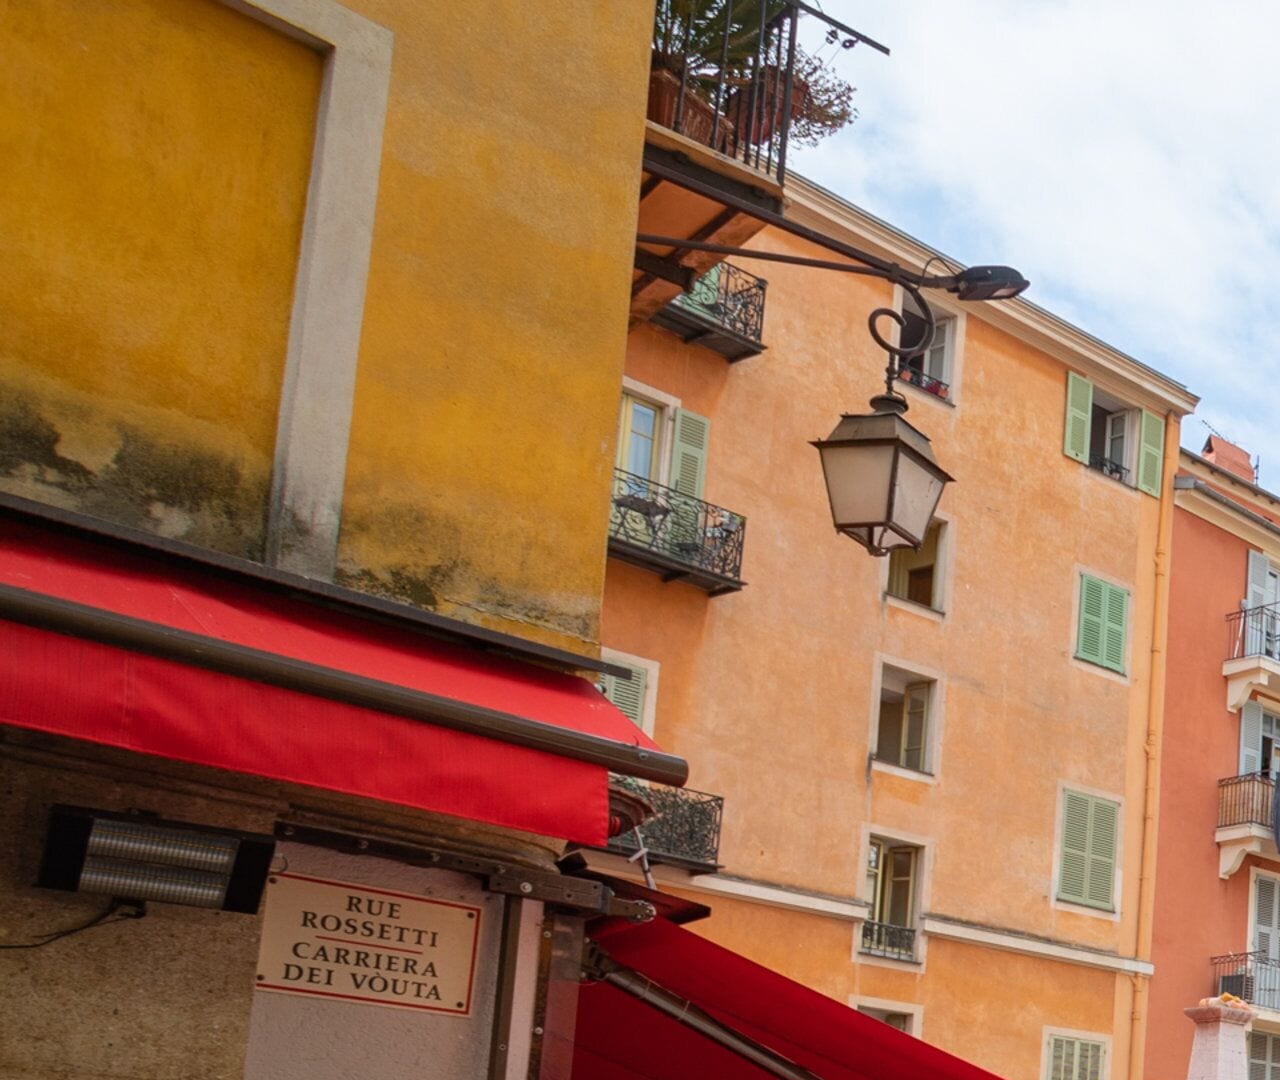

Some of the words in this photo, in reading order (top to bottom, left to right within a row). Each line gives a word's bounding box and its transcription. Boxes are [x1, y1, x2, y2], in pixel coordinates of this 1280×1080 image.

[345, 895, 402, 920] RUE
[301, 910, 439, 948] ROSSETTI
[291, 942, 439, 978] CARRIERA
[282, 962, 334, 986] DEI
[350, 971, 442, 1001] VÒUTA
